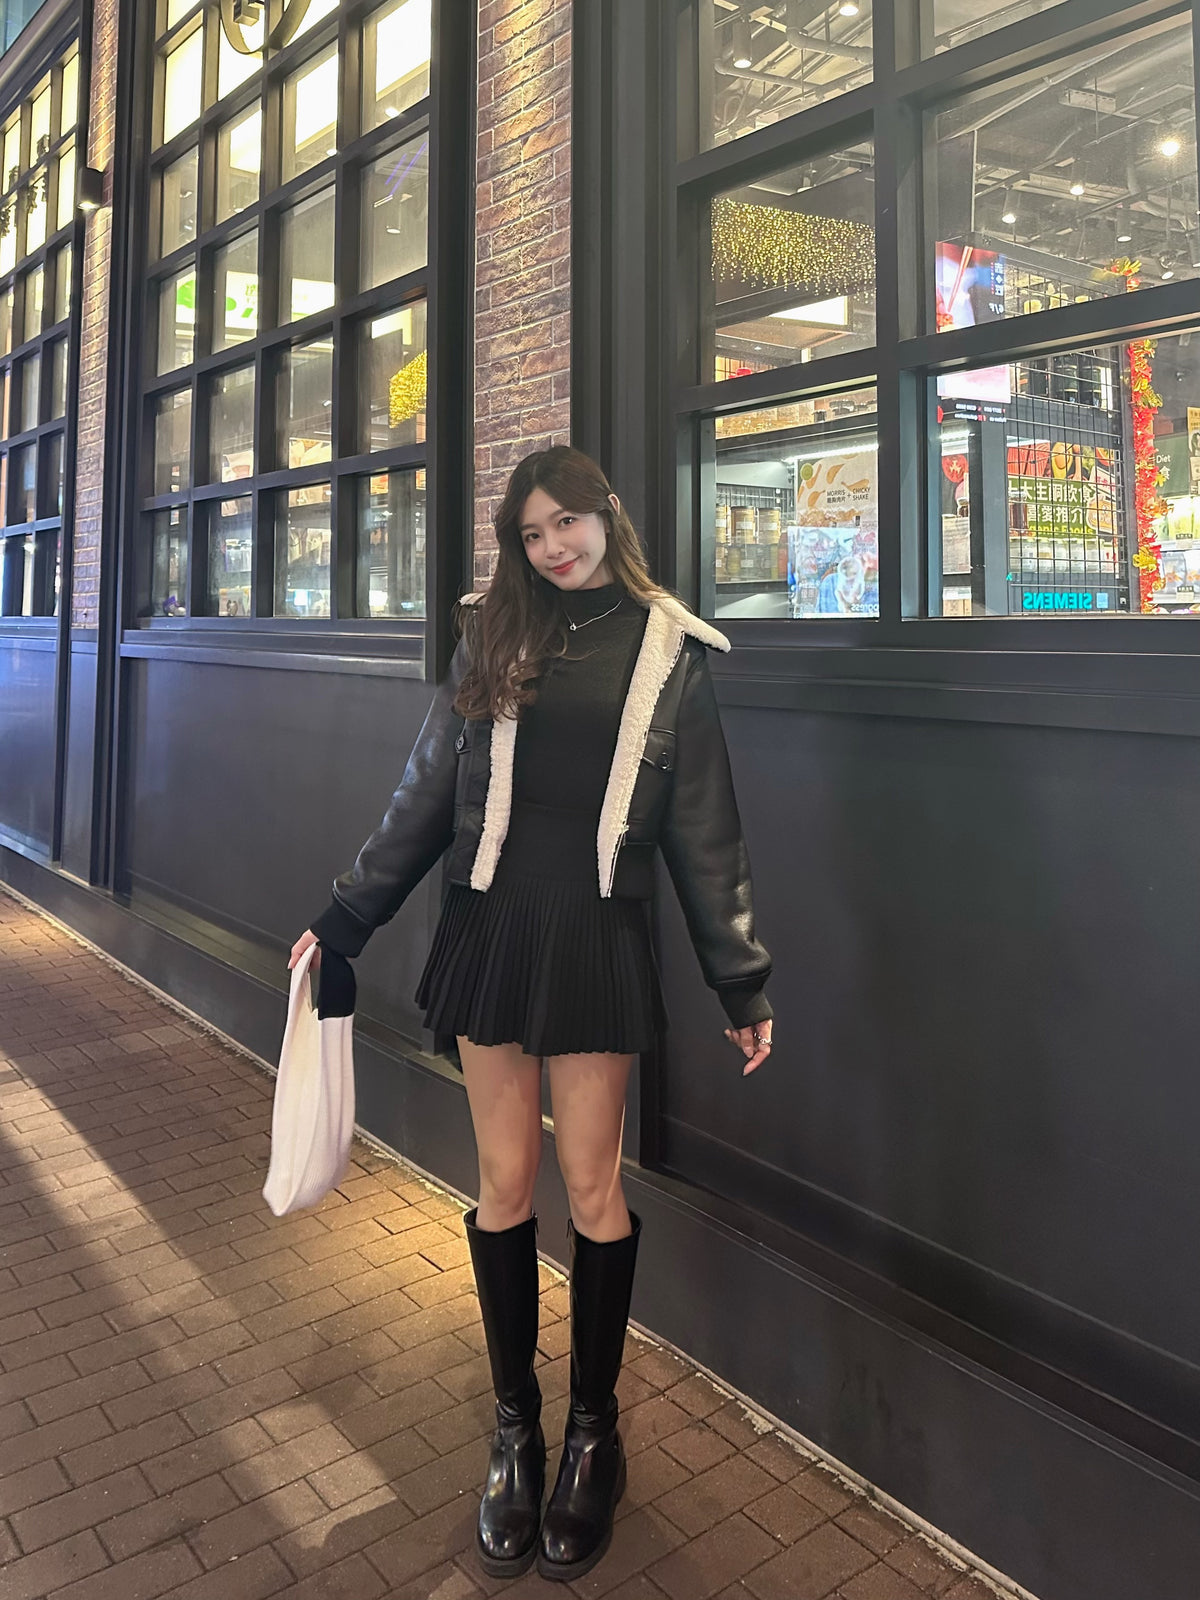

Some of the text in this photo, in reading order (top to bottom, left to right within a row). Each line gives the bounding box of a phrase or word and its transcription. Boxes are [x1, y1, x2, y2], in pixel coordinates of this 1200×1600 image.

[1156, 454, 1171, 464] Diet
[826, 489, 846, 497] MORRIS
[852, 493, 869, 501] SHAKE
[1027, 503, 1083, 523] 喜愛推介
